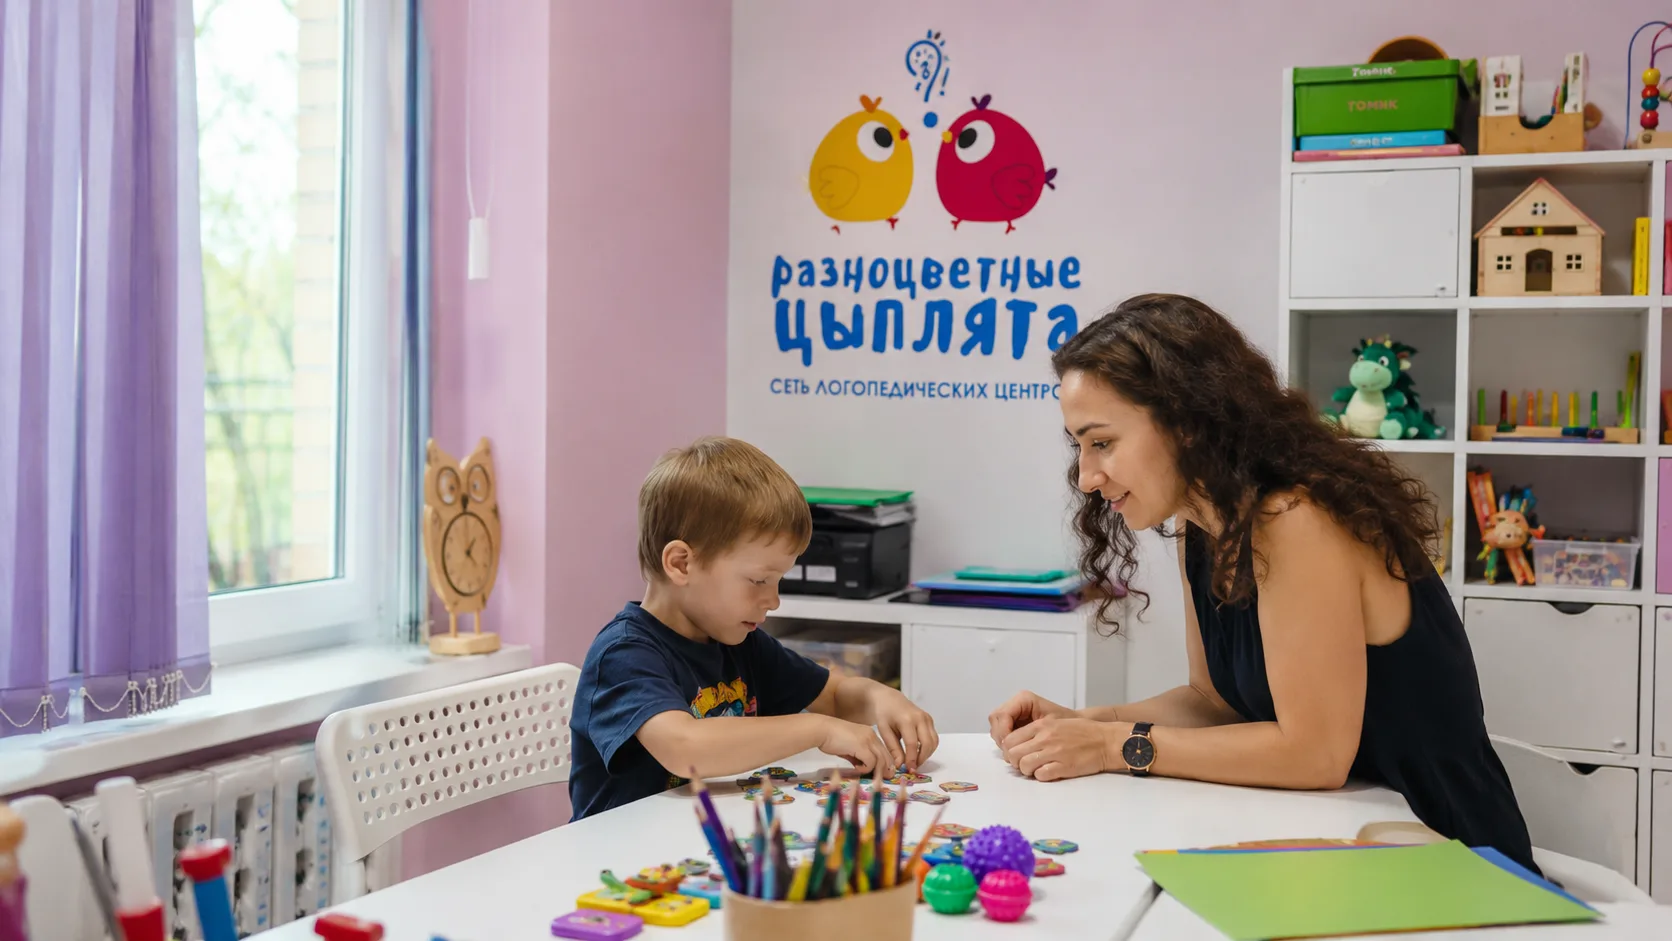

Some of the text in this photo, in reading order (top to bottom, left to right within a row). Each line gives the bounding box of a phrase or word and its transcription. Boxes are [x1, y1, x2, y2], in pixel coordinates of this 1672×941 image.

[771, 255, 1081, 300] разноцветные
[770, 378, 1061, 401] СЕТЬ ЛОГОПЕДИЧЕСКИХ ЦЕНТРО
